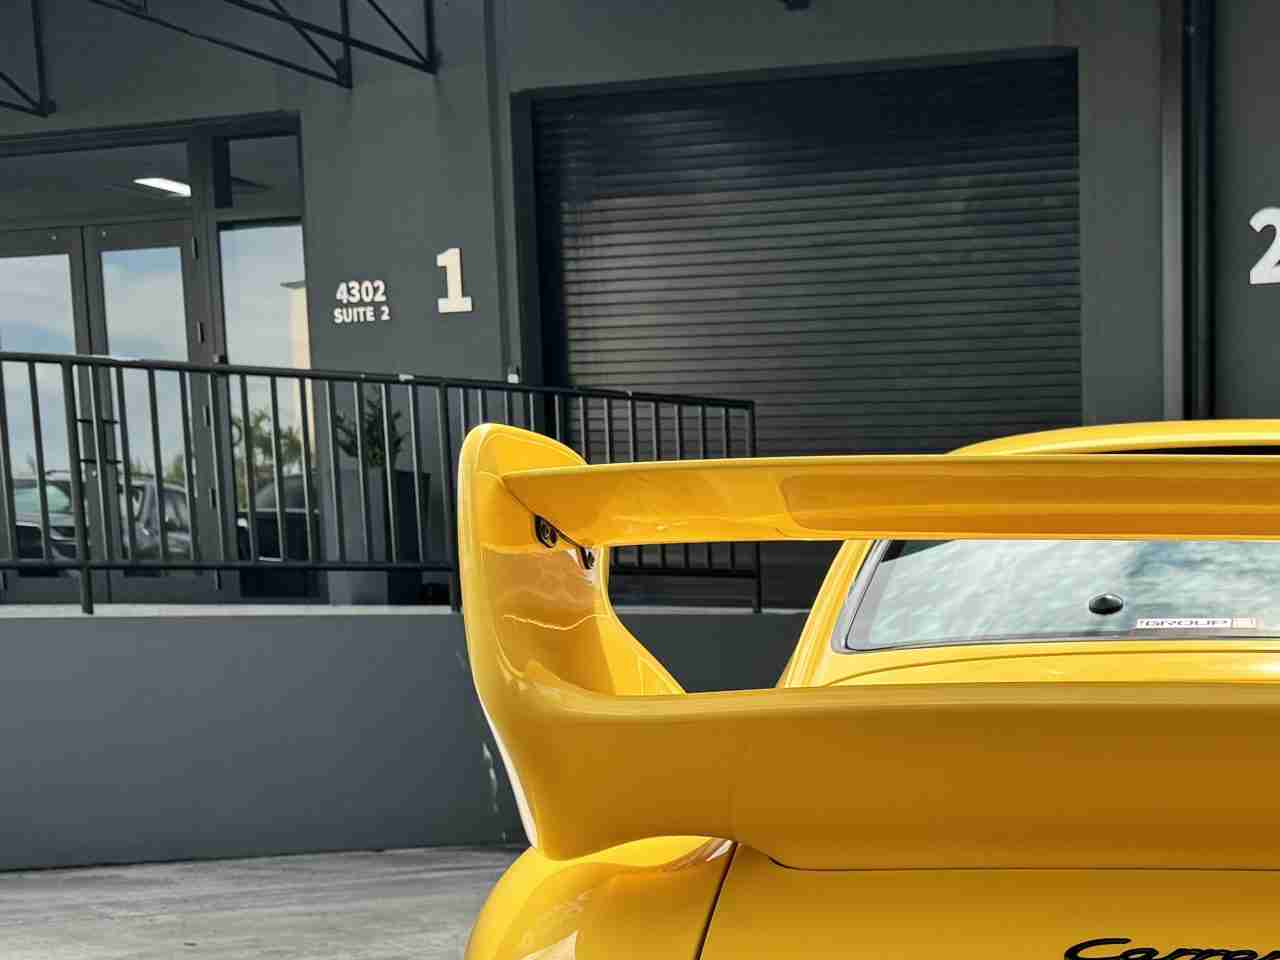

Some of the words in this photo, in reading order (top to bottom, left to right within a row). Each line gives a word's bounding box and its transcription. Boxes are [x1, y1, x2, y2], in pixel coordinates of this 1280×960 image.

[335, 279, 387, 304] 4302
[436, 247, 473, 313] 1
[333, 306, 376, 324] SUITE
[380, 305, 391, 321] 2
